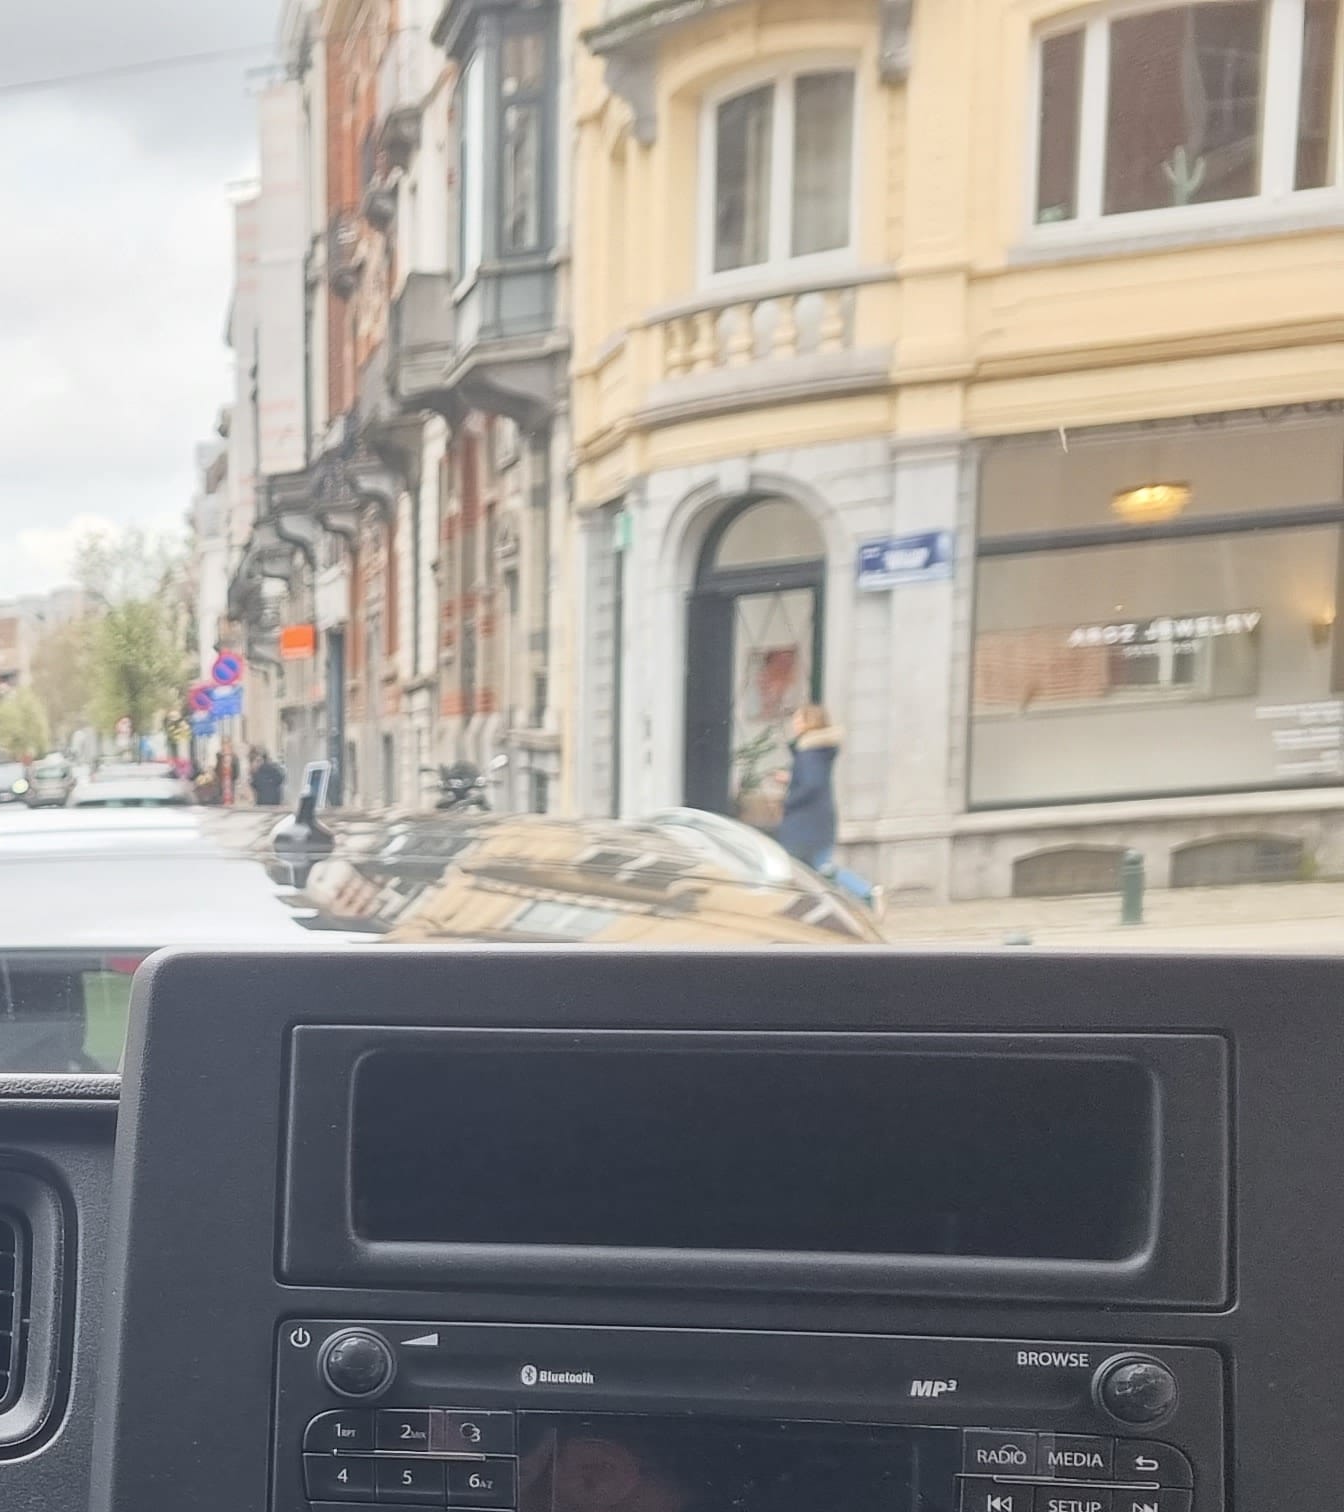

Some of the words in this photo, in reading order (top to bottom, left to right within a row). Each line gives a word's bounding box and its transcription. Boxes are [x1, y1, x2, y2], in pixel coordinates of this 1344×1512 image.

[1017, 1351, 1089, 1368] BROWSE
[539, 1369, 594, 1386] Bluetooth
[400, 1424, 412, 1439] 2
[470, 1427, 481, 1443] 3
[977, 1450, 1027, 1465] RADIO
[1048, 1451, 1104, 1468] MEDIA
[337, 1468, 348, 1483] 4
[402, 1469, 413, 1484] 5
[468, 1473, 480, 1489] 6
